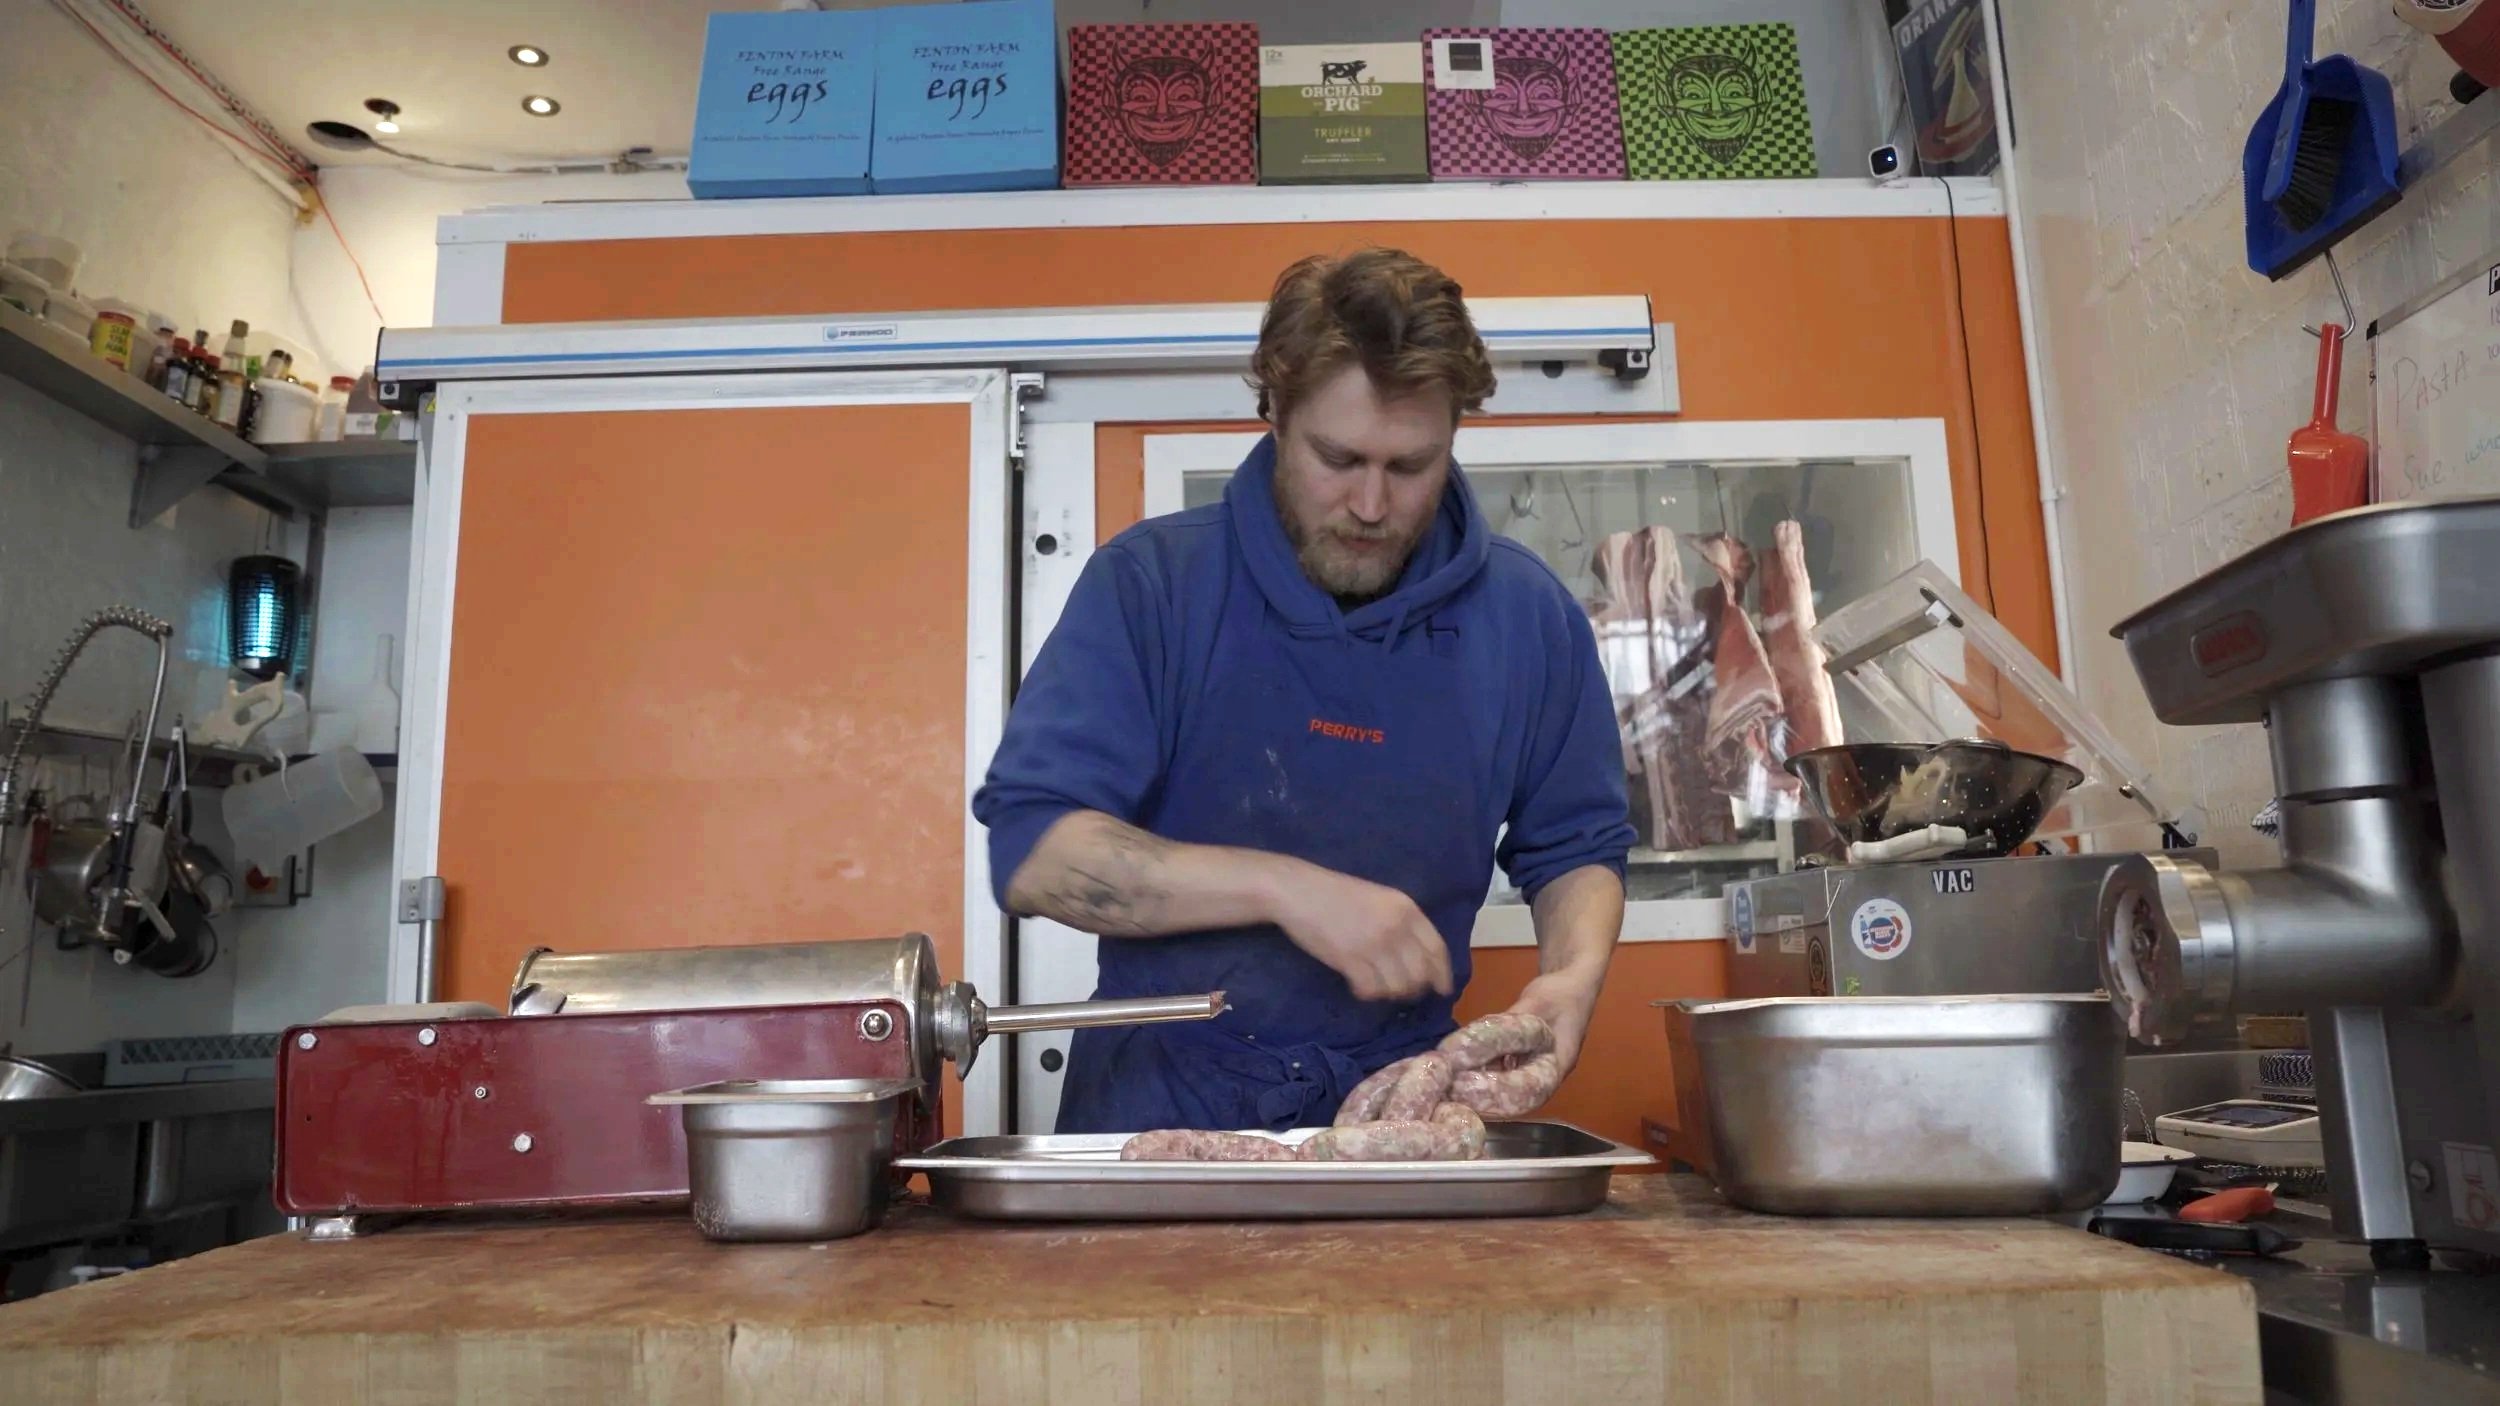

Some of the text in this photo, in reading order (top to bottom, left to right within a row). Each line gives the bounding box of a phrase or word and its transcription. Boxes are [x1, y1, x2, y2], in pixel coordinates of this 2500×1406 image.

[753, 65, 779, 76] Free
[930, 61, 957, 72] Free
[927, 72, 1008, 121] eggs
[1301, 84, 1383, 98] ORCHARD
[747, 79, 829, 124] eggs
[1324, 97, 1361, 112] PIG
[1314, 125, 1372, 139] TRUFFLER
[1309, 718, 1385, 744] PERRY'S
[1932, 869, 1972, 892] VAC
